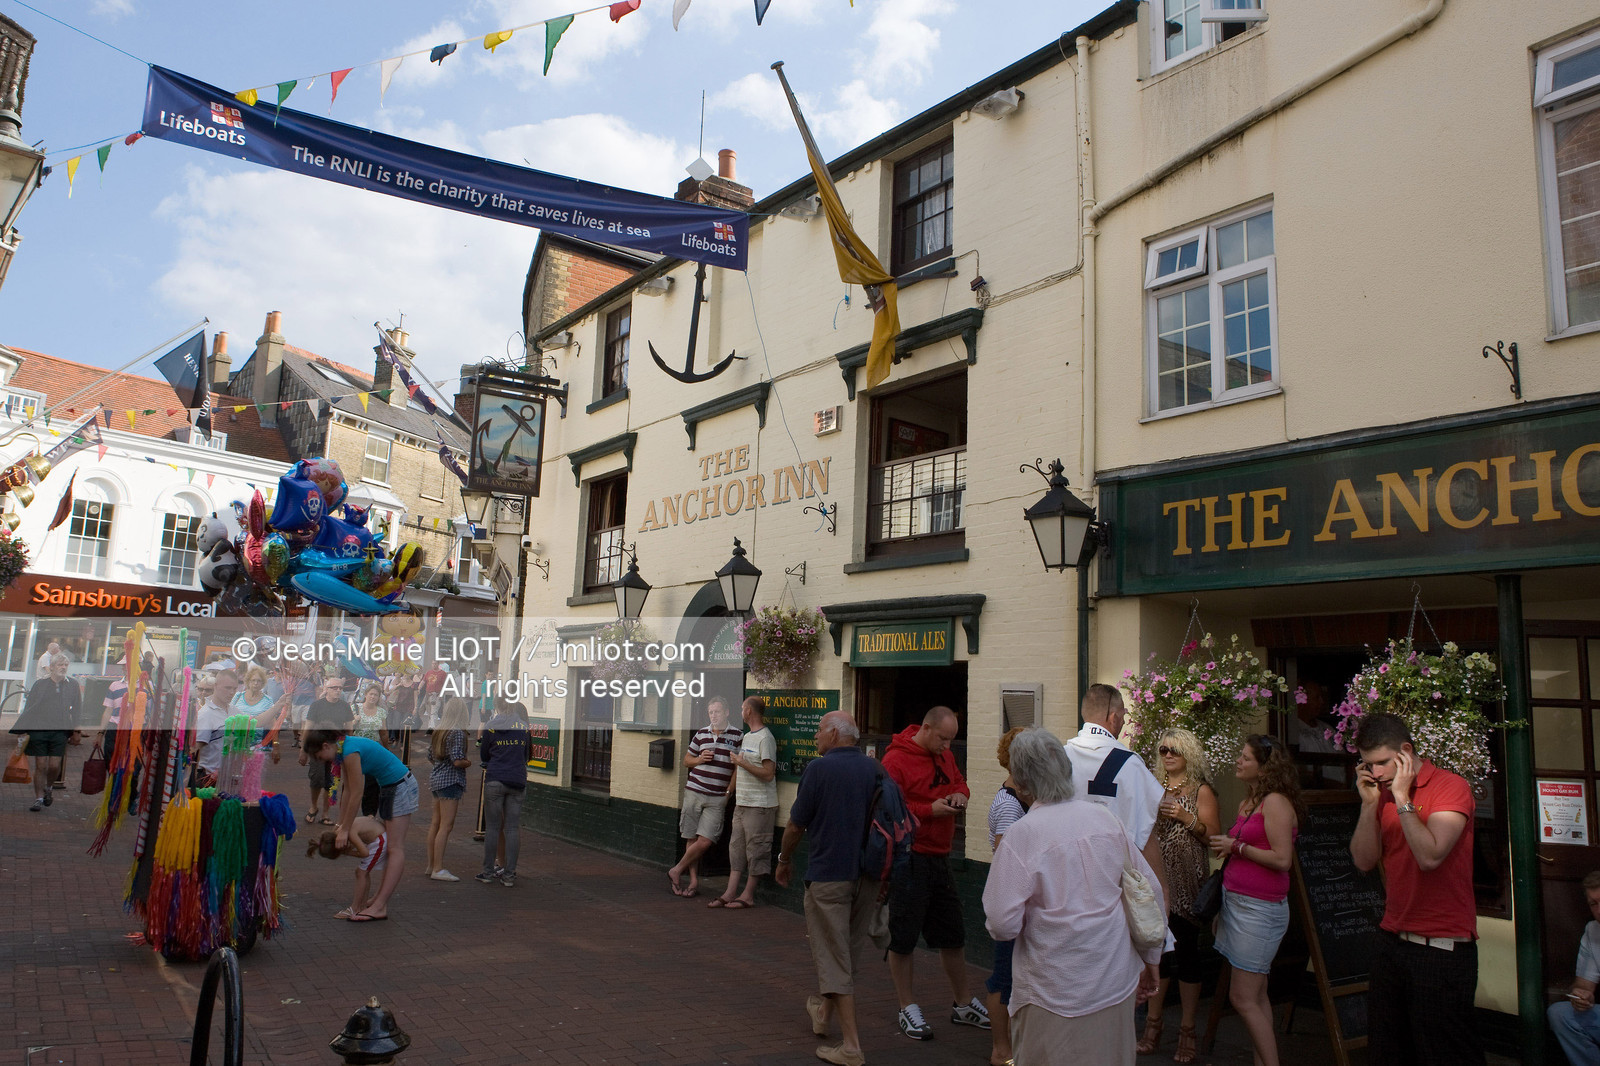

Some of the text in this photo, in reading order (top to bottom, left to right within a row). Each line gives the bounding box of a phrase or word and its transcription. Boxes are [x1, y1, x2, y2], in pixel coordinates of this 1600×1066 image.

[159, 110, 246, 146] Lifeboats
[291, 145, 651, 238] The RNLI is the charity that saves lives at sea
[681, 232, 737, 257] Lifeboats
[698, 443, 750, 481] THE
[475, 477, 532, 490] THE ANCHOR INN
[638, 456, 832, 533] ANCHOR INN
[1162, 486, 1292, 556] THE
[32, 582, 216, 618] Sainsbury's Local
[858, 630, 946, 653] TRADITIONAL ALES
[773, 696, 808, 708] ANCHOR
[811, 697, 827, 709] INN
[773, 717, 789, 725] TIMES
